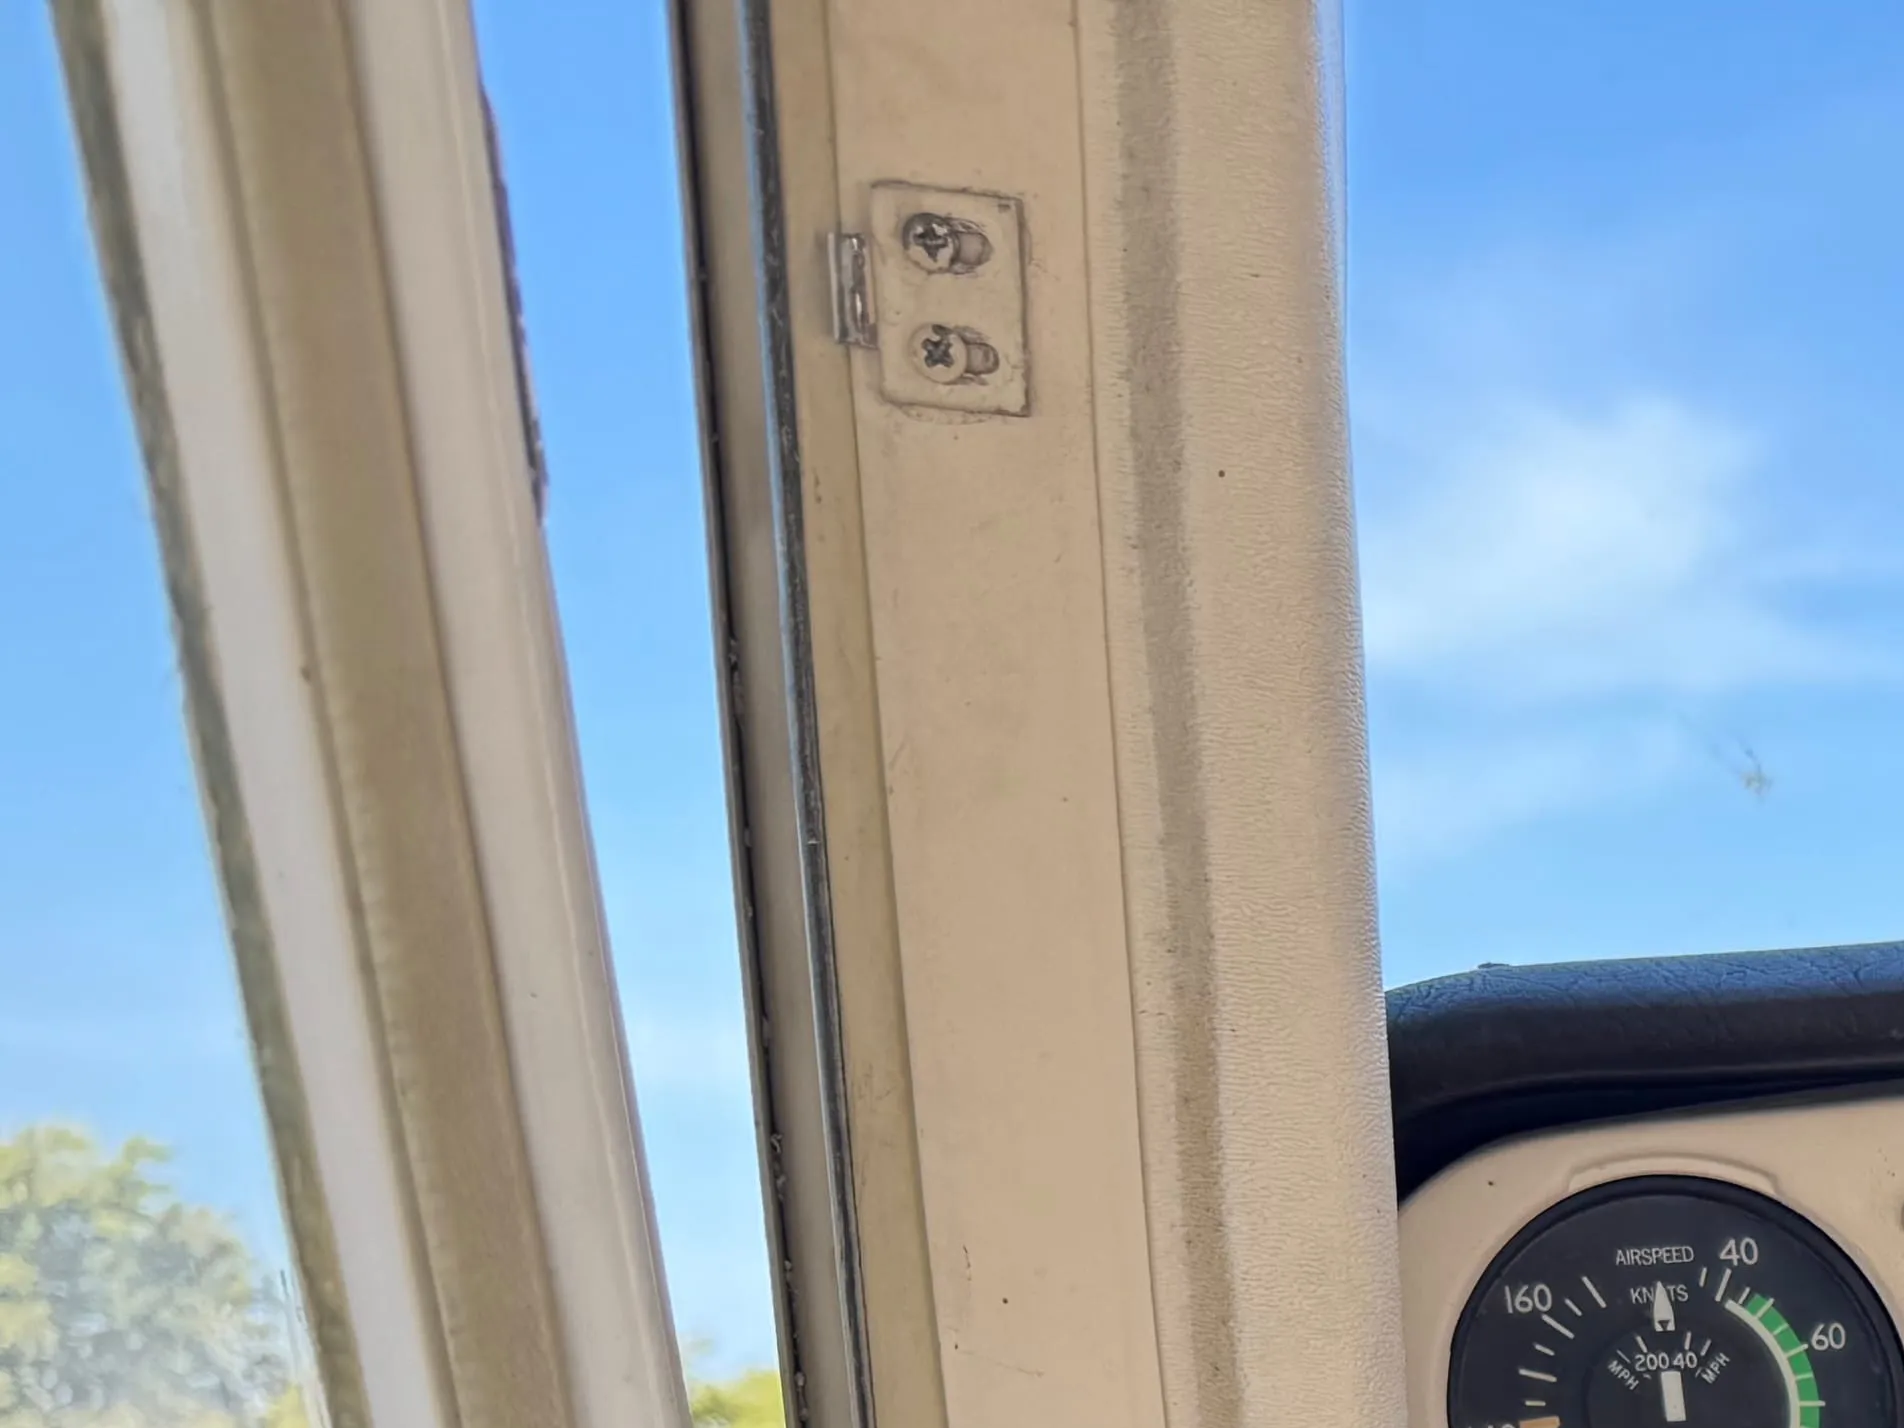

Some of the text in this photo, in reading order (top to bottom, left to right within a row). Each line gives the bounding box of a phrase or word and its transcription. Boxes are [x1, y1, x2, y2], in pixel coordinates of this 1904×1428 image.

[1615, 1246, 1695, 1266] AIRSPEED
[1720, 1238, 1759, 1267] 40
[1504, 1284, 1552, 1313] 160
[1811, 1322, 1846, 1350] 60
[1608, 1360, 1639, 1391] MPH
[1635, 1354, 1698, 1371] 200 40
[1702, 1353, 1730, 1384] MPH
